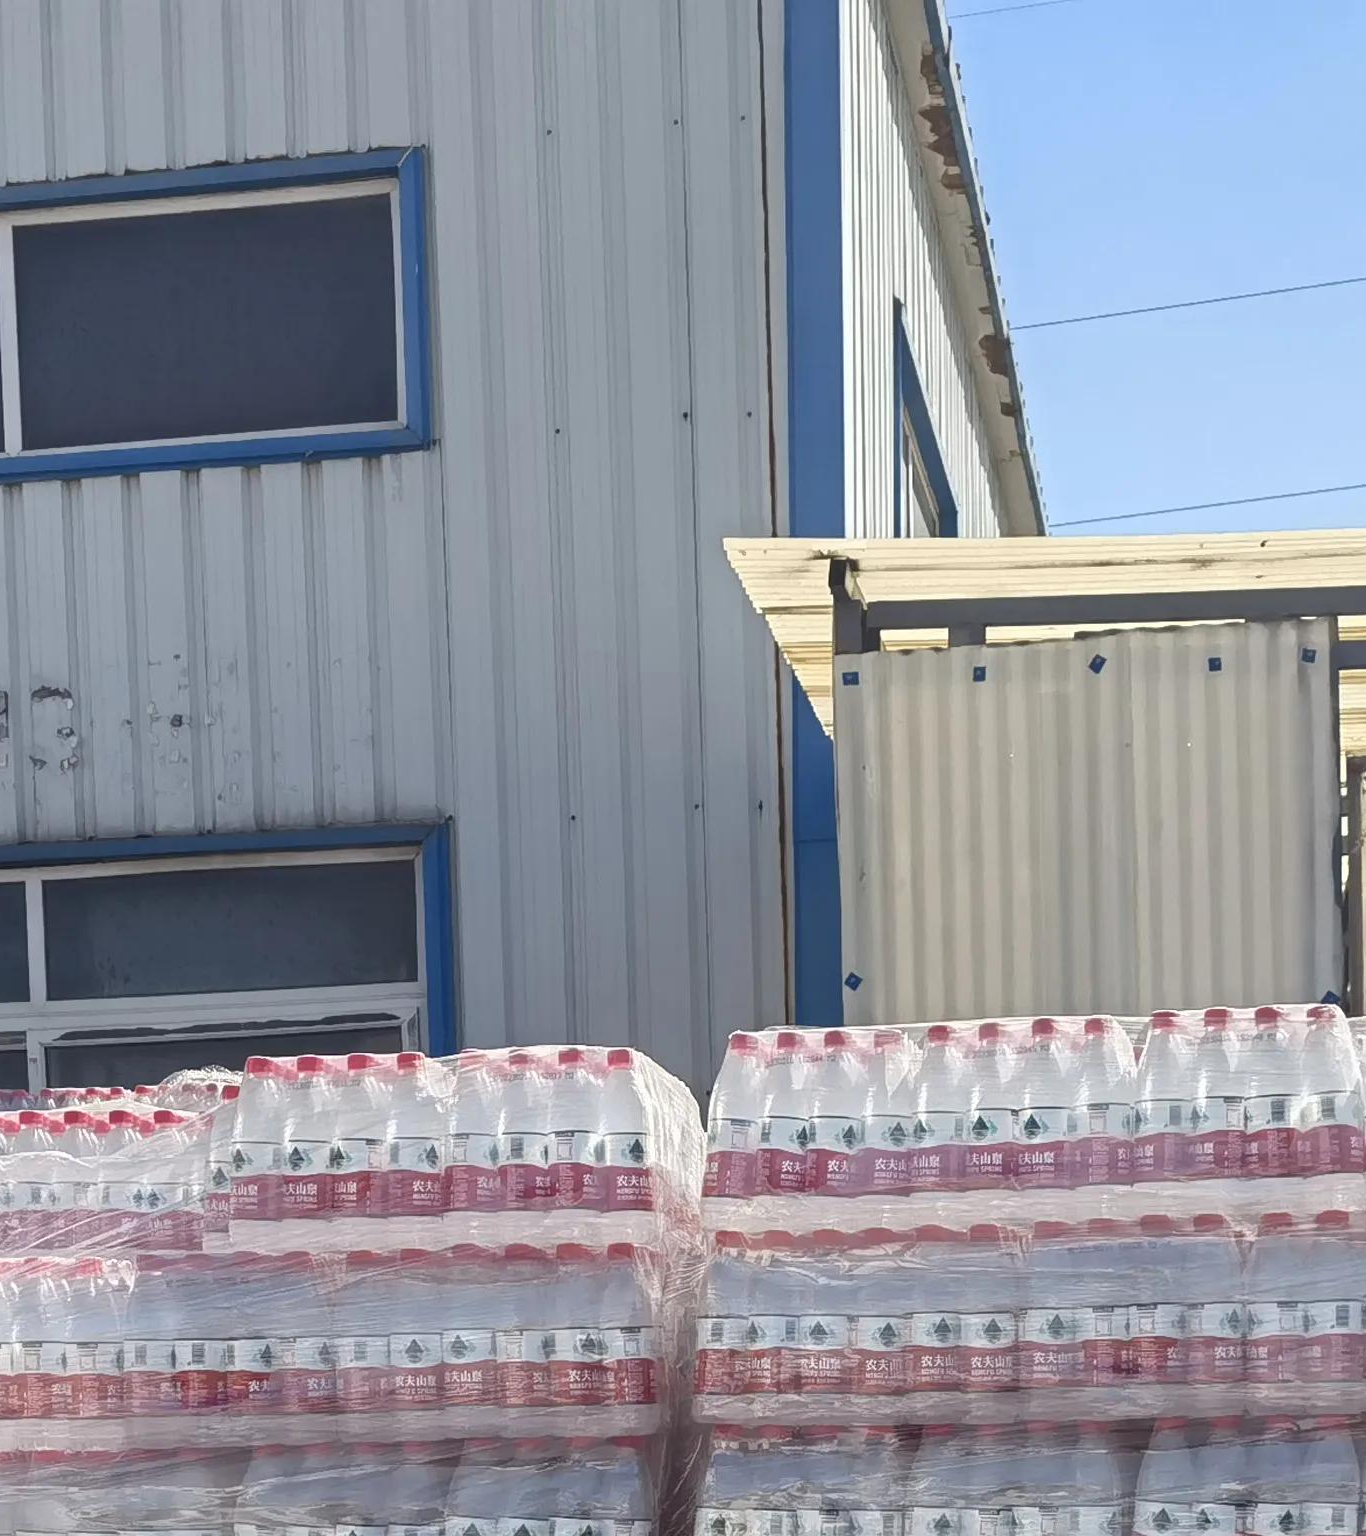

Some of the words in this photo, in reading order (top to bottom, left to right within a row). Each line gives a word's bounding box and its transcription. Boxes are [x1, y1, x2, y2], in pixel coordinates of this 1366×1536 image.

[967, 1153, 1003, 1167] 夫山泉
[1019, 1152, 1055, 1166] 夫山泉
[284, 1183, 317, 1195] 夫山泉
[616, 1176, 653, 1189] 农夫山
[231, 1184, 259, 1195] 夫山泉
